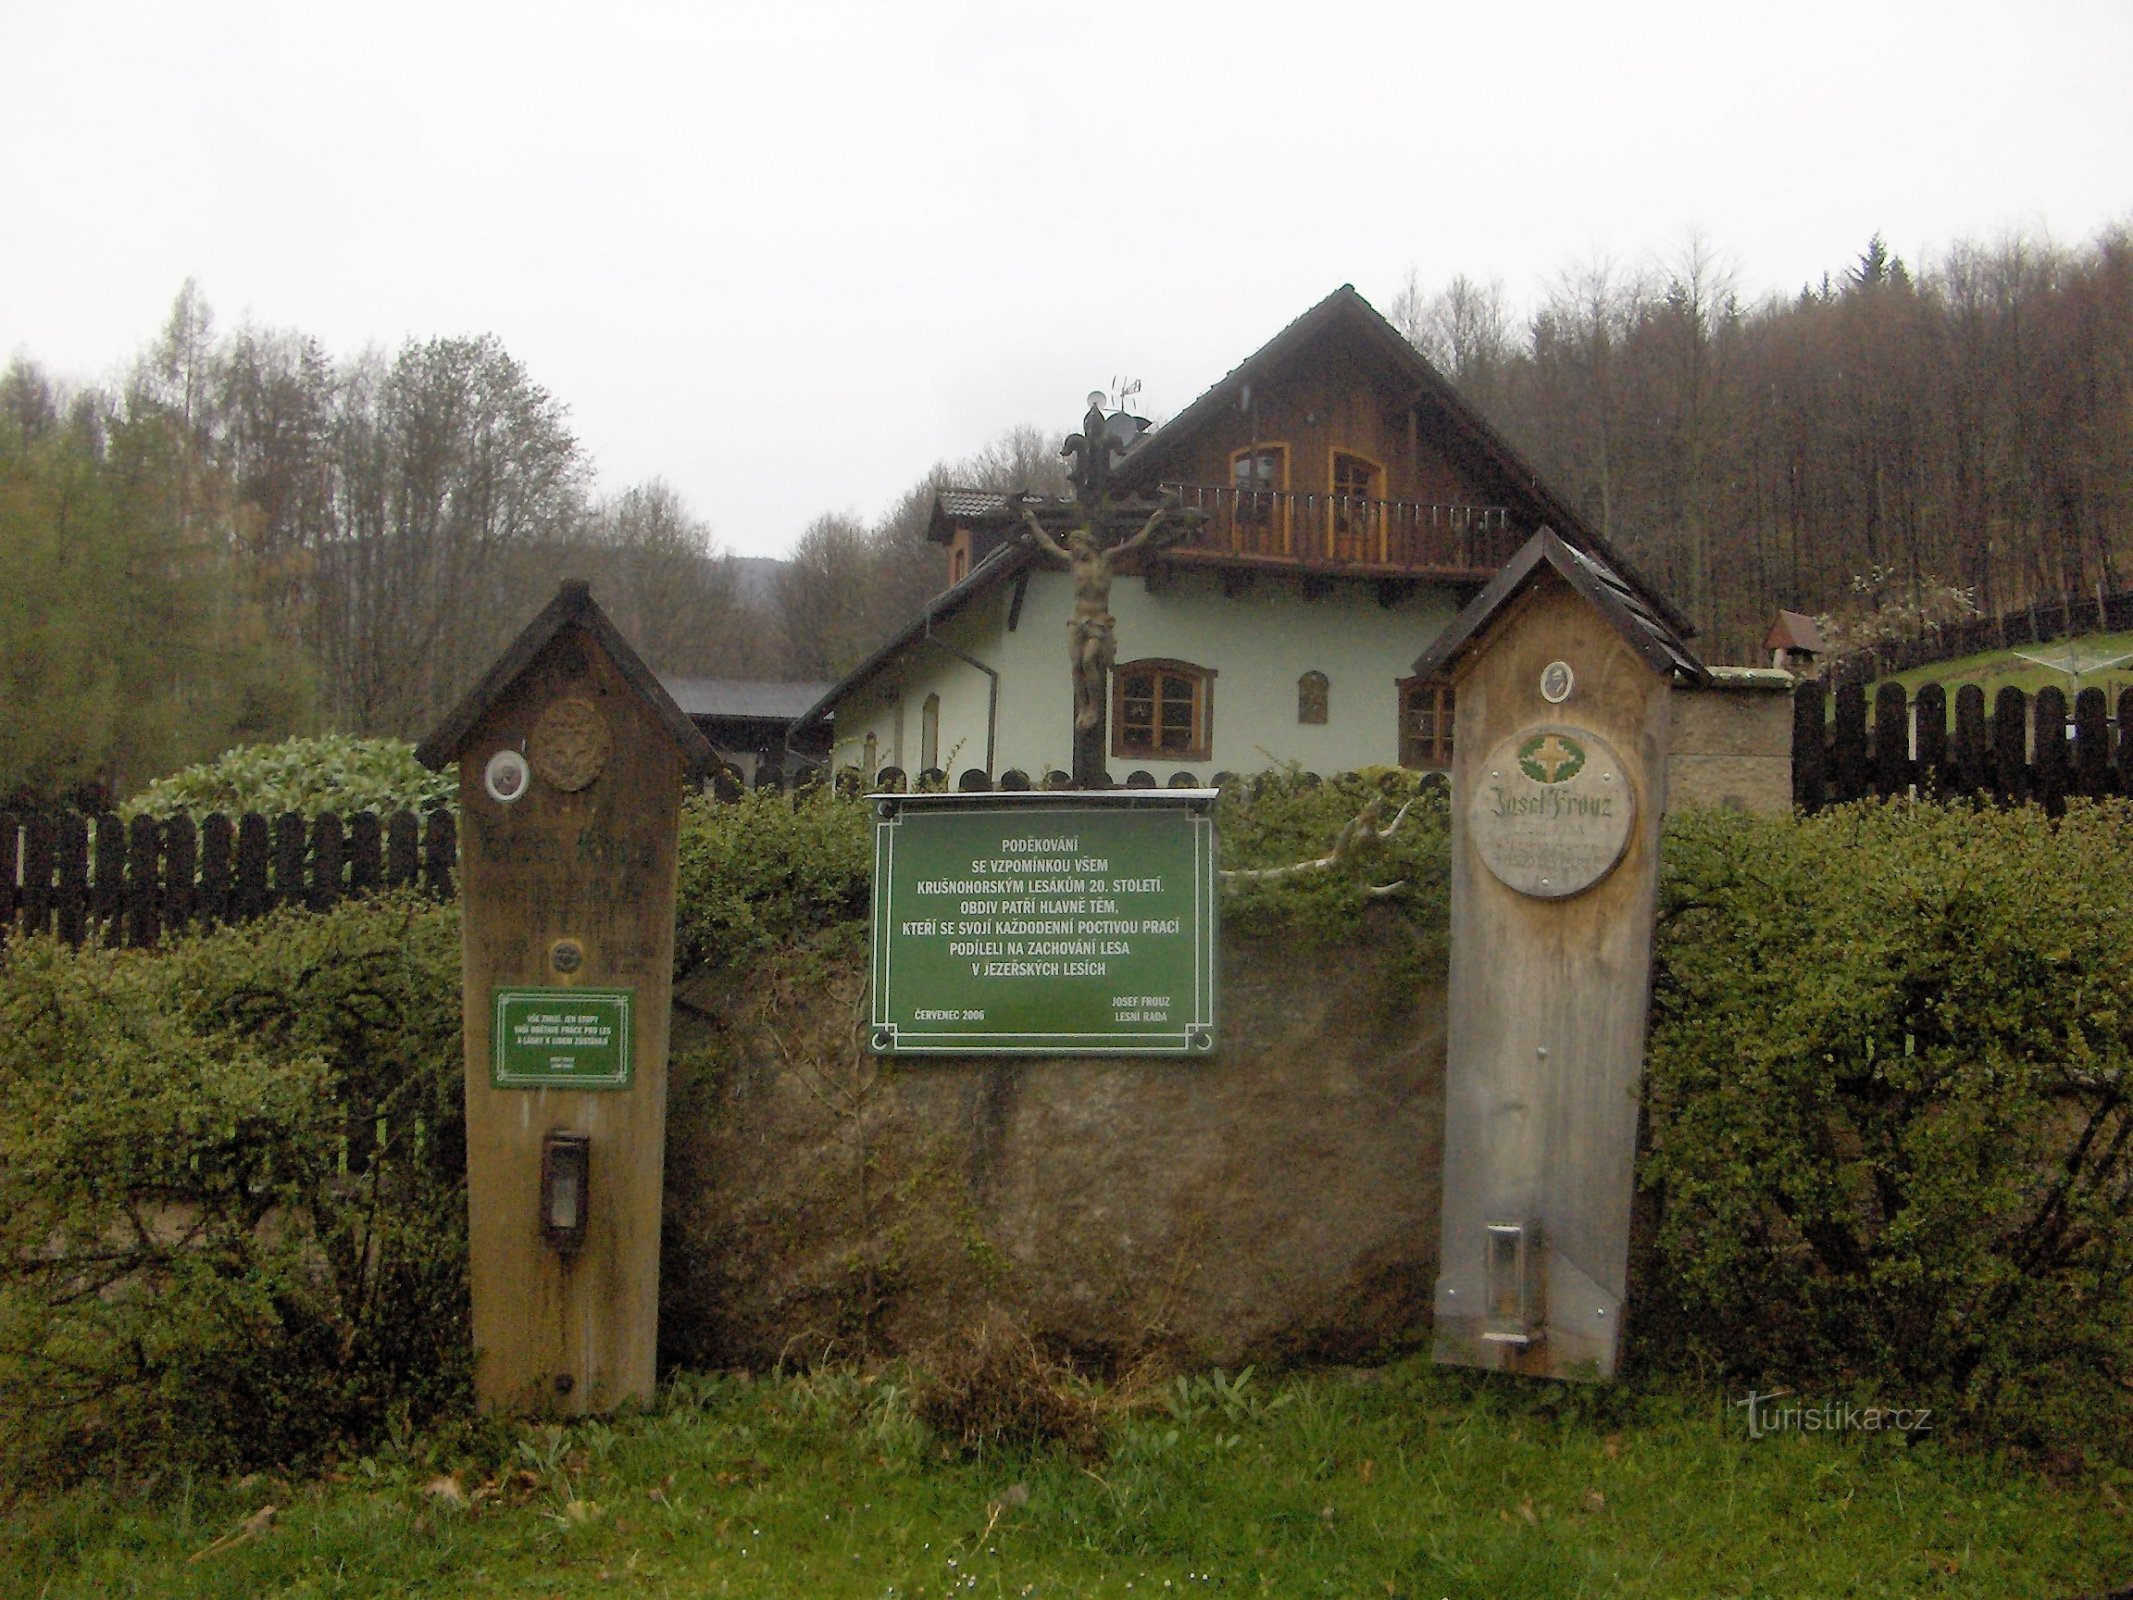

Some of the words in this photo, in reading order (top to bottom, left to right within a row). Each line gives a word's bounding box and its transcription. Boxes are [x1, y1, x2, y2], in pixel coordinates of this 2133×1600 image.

[1001, 834, 1079, 853] PODĚKOVÁNÍ
[971, 859, 987, 873] SE
[990, 856, 1071, 873] VZPOMÍNKOU
[1074, 855, 1108, 873] VŠEM
[917, 877, 1024, 895] KRUŠNOHORSKÝM
[1028, 876, 1085, 893] LESÁKŮM
[1089, 879, 1109, 893] 20.
[1112, 876, 1165, 893] STOLETÍ.
[960, 900, 998, 915] OBDIV
[1001, 898, 1036, 914] PATŘÍ
[1040, 897, 1086, 914] HLAVNĚ
[1089, 897, 1119, 915] TĚM,
[902, 918, 937, 936] KTEŘÍ
[940, 921, 955, 935] SE
[958, 918, 992, 935] SVOJÍ
[995, 917, 1075, 935] KAŽDODENNÍ
[1078, 920, 1138, 935] POCTIVOU
[1142, 917, 1180, 934] PRACÍ
[950, 939, 1003, 956] PODÍLELI
[1007, 942, 1025, 955] NA
[1027, 938, 1097, 955] ZACHOVÁNÍ
[1100, 941, 1131, 955] LESA
[971, 962, 981, 976] V
[983, 959, 1059, 976] JEZEŘSKÝCH
[1063, 959, 1106, 976] LESÍCH
[1112, 995, 1139, 1007] JOSEF
[1141, 995, 1171, 1007] FROUZ
[914, 1007, 960, 1020] ČERVENEC
